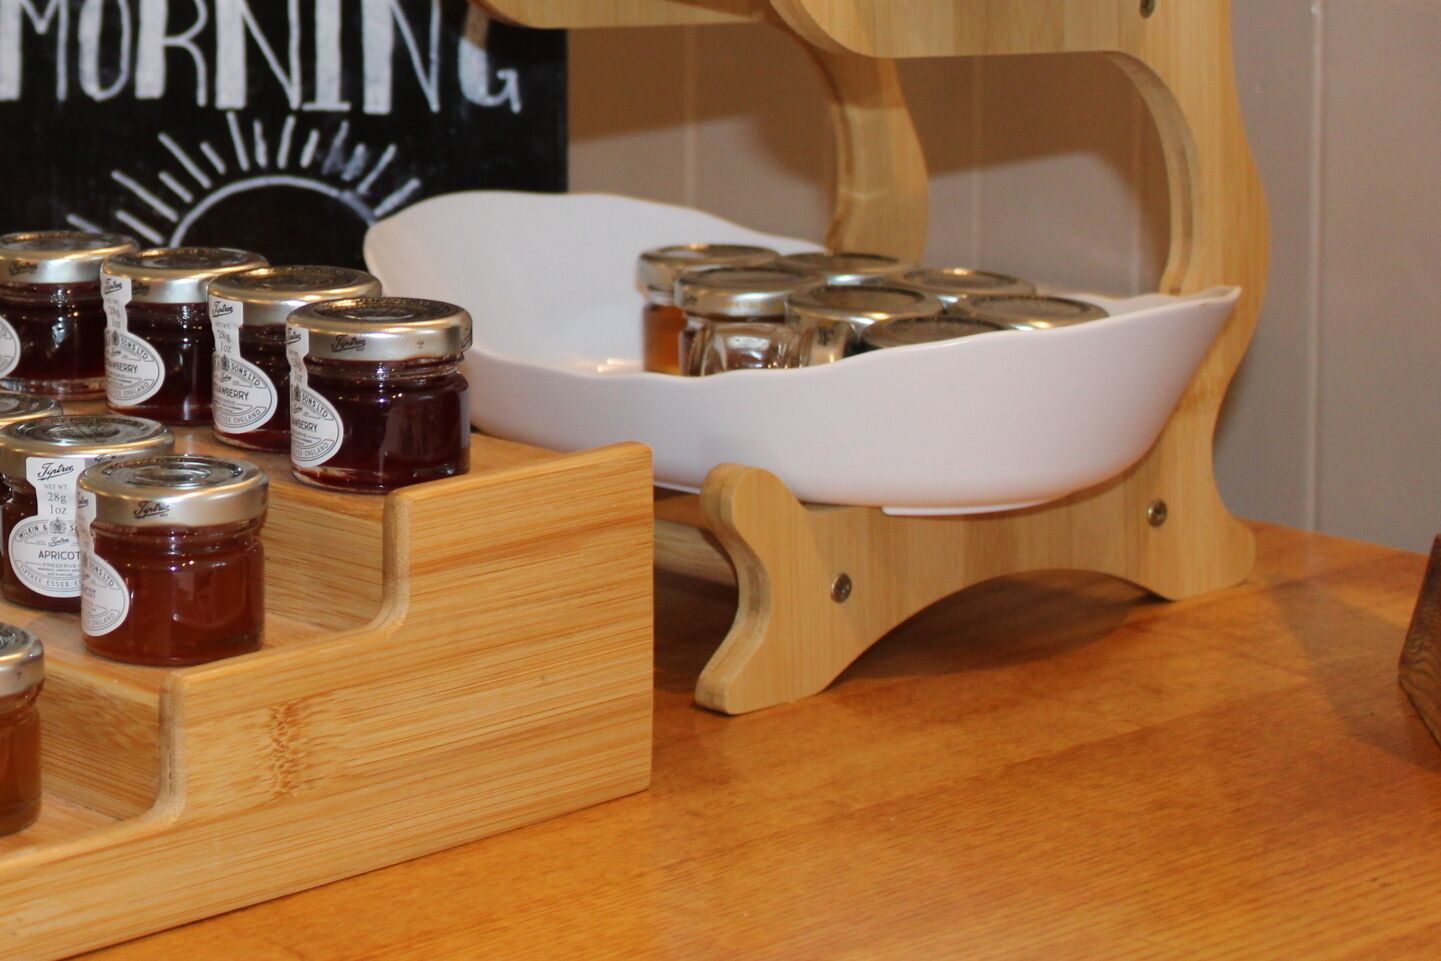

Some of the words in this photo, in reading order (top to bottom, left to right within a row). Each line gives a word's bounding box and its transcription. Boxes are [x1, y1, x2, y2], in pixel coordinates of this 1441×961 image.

[230, 363, 247, 377] SONS
[247, 373, 261, 386] LTD
[233, 409, 261, 423] ENGLAND
[316, 405, 328, 418] LTD
[37, 462, 74, 481] Tiptree
[47, 492, 67, 504] 28g
[50, 503, 67, 515] 1oz
[17, 524, 39, 540] WILKIN
[38, 550, 80, 561] APRICOT
